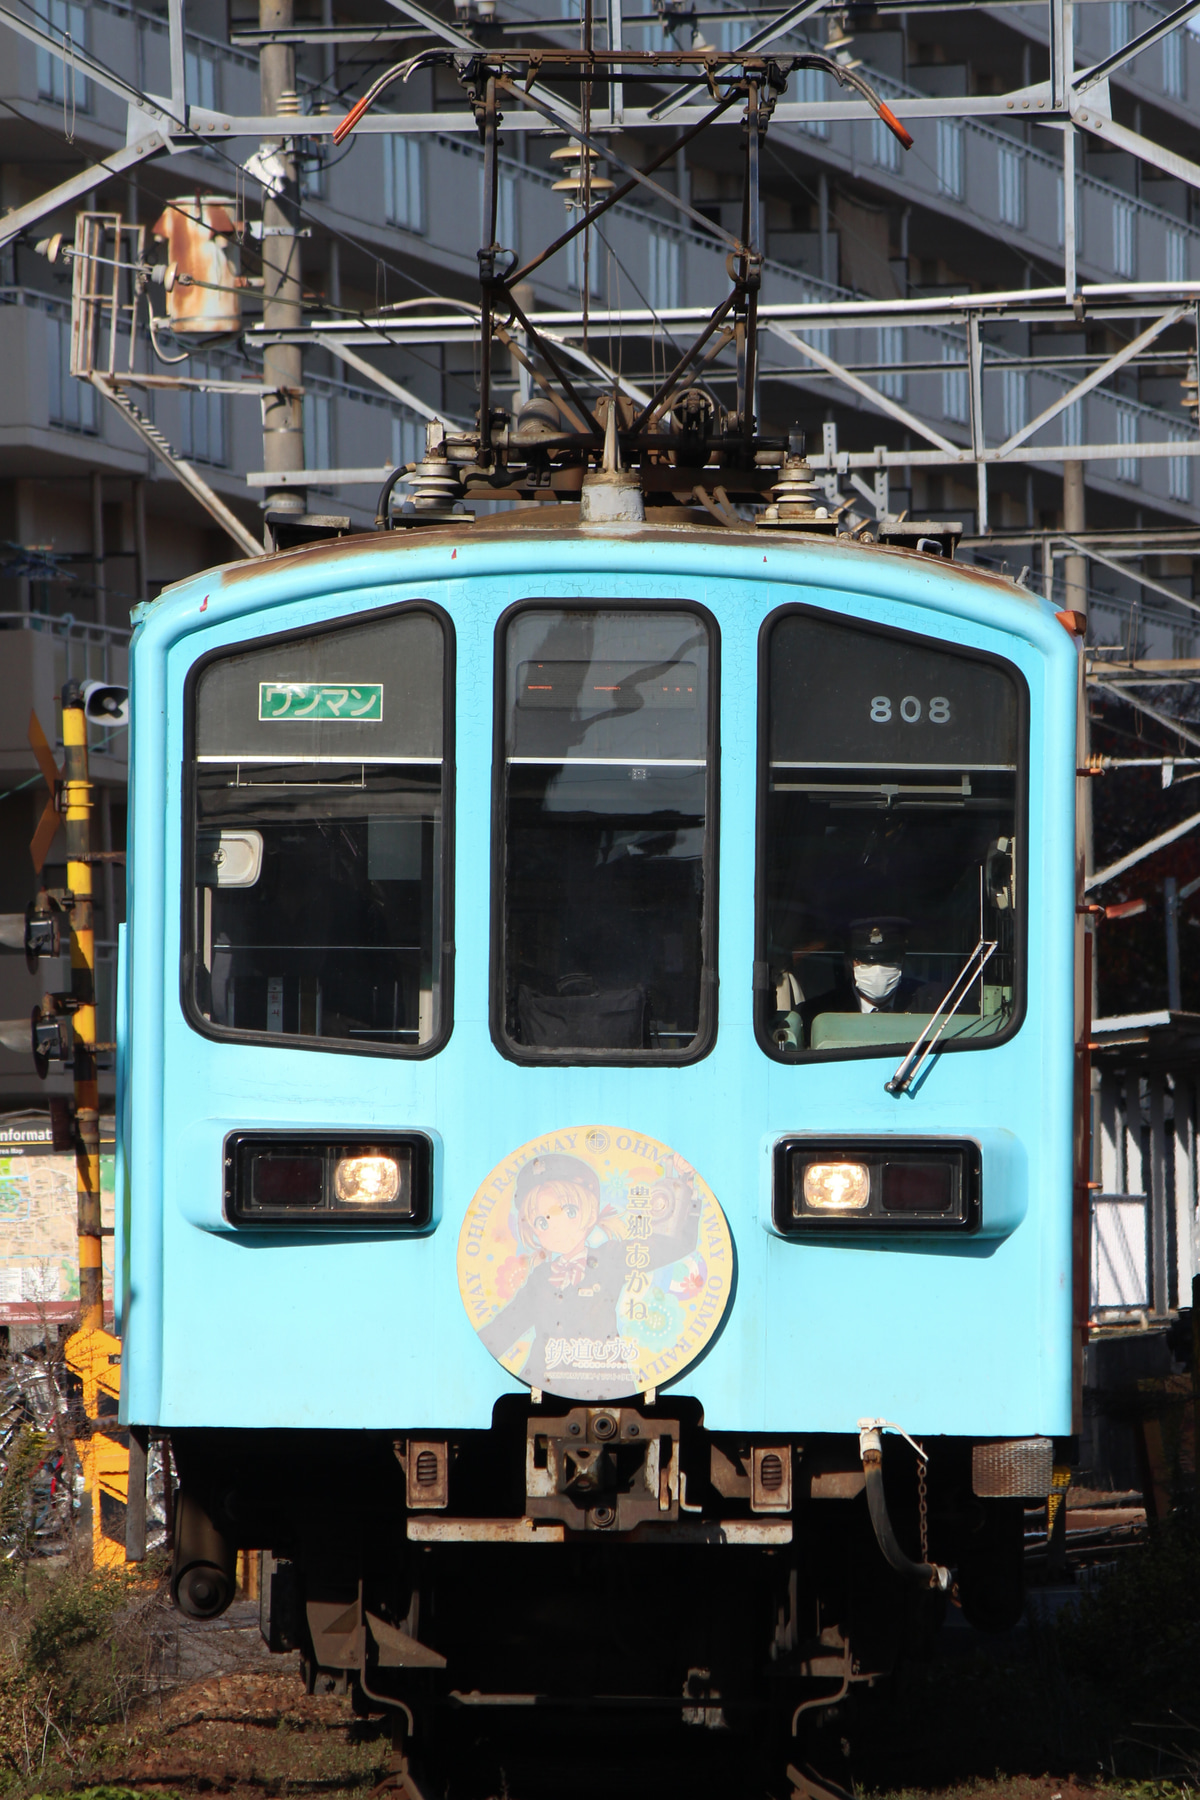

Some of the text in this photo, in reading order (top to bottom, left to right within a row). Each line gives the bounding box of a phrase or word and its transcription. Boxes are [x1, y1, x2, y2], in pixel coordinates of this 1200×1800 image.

[266, 688, 377, 716] ワンマン
[870, 696, 951, 724] 808
[0, 1128, 53, 1141] nformat
[616, 1135, 667, 1167] OHM
[466, 1193, 497, 1257] OHMI
[625, 1186, 652, 1320] 豊郷あかね
[689, 1275, 723, 1338] OHMI
[545, 1337, 639, 1370] 鉄道むすめ
